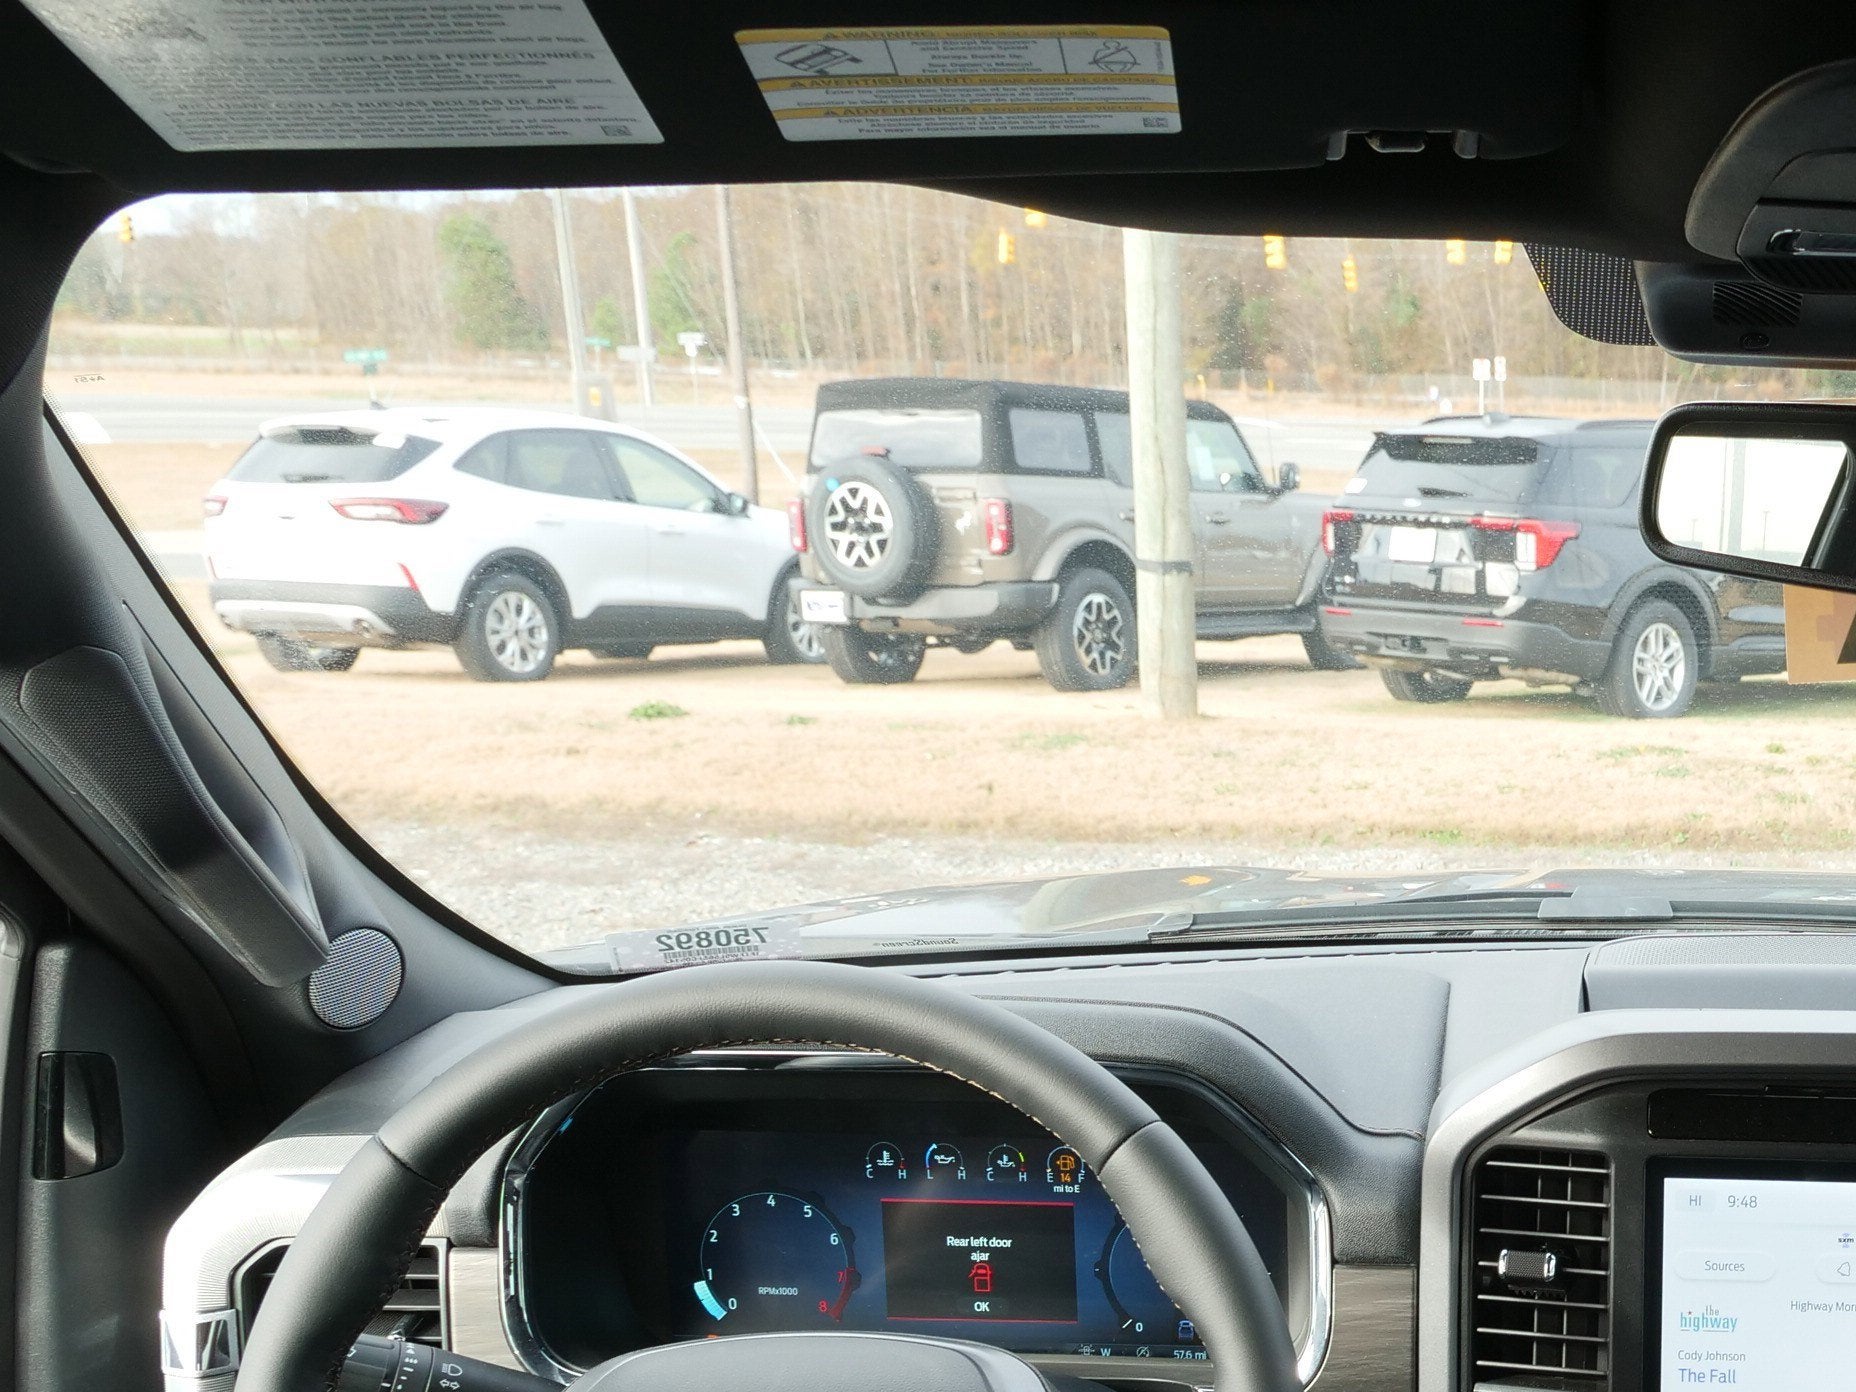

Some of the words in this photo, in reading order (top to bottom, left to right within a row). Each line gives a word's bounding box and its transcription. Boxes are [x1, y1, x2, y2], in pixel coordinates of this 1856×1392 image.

[866, 1169, 874, 1179] C
[898, 1169, 907, 1179] H
[927, 1170, 934, 1179] L
[958, 1170, 966, 1180] H
[987, 1171, 995, 1181] C
[1019, 1172, 1027, 1182] H
[1047, 1172, 1054, 1183] E
[1060, 1173, 1071, 1182] 14
[1078, 1173, 1085, 1183] F
[1054, 1185, 1064, 1193] mi
[767, 1194, 776, 1207] 4
[1689, 1196, 1701, 1207] HI
[1728, 1196, 1758, 1209] 9:48
[732, 1204, 740, 1217] 3
[804, 1205, 812, 1218] 5
[710, 1230, 718, 1242] 2
[830, 1233, 839, 1245] 6
[946, 1236, 969, 1247] Rear
[970, 1236, 988, 1247] left
[989, 1237, 1012, 1248] door
[970, 1250, 990, 1262] ajar
[1704, 1260, 1745, 1272] Sources
[706, 1268, 713, 1281] 1
[837, 1271, 844, 1284] 7
[728, 1298, 737, 1310] 0
[818, 1300, 828, 1312] 8
[974, 1302, 990, 1312] OK
[1790, 1300, 1834, 1314] Highway
[1706, 1305, 1720, 1316] the
[1136, 1322, 1143, 1332] 0
[1680, 1311, 1738, 1332] highway
[1100, 1348, 1111, 1357] W
[1174, 1350, 1193, 1360] 57.6
[1194, 1351, 1207, 1360] mi
[1678, 1350, 1703, 1362] Cody
[1704, 1350, 1746, 1362] Johnson
[1678, 1368, 1706, 1383] The
[1710, 1368, 1736, 1384] Fall
